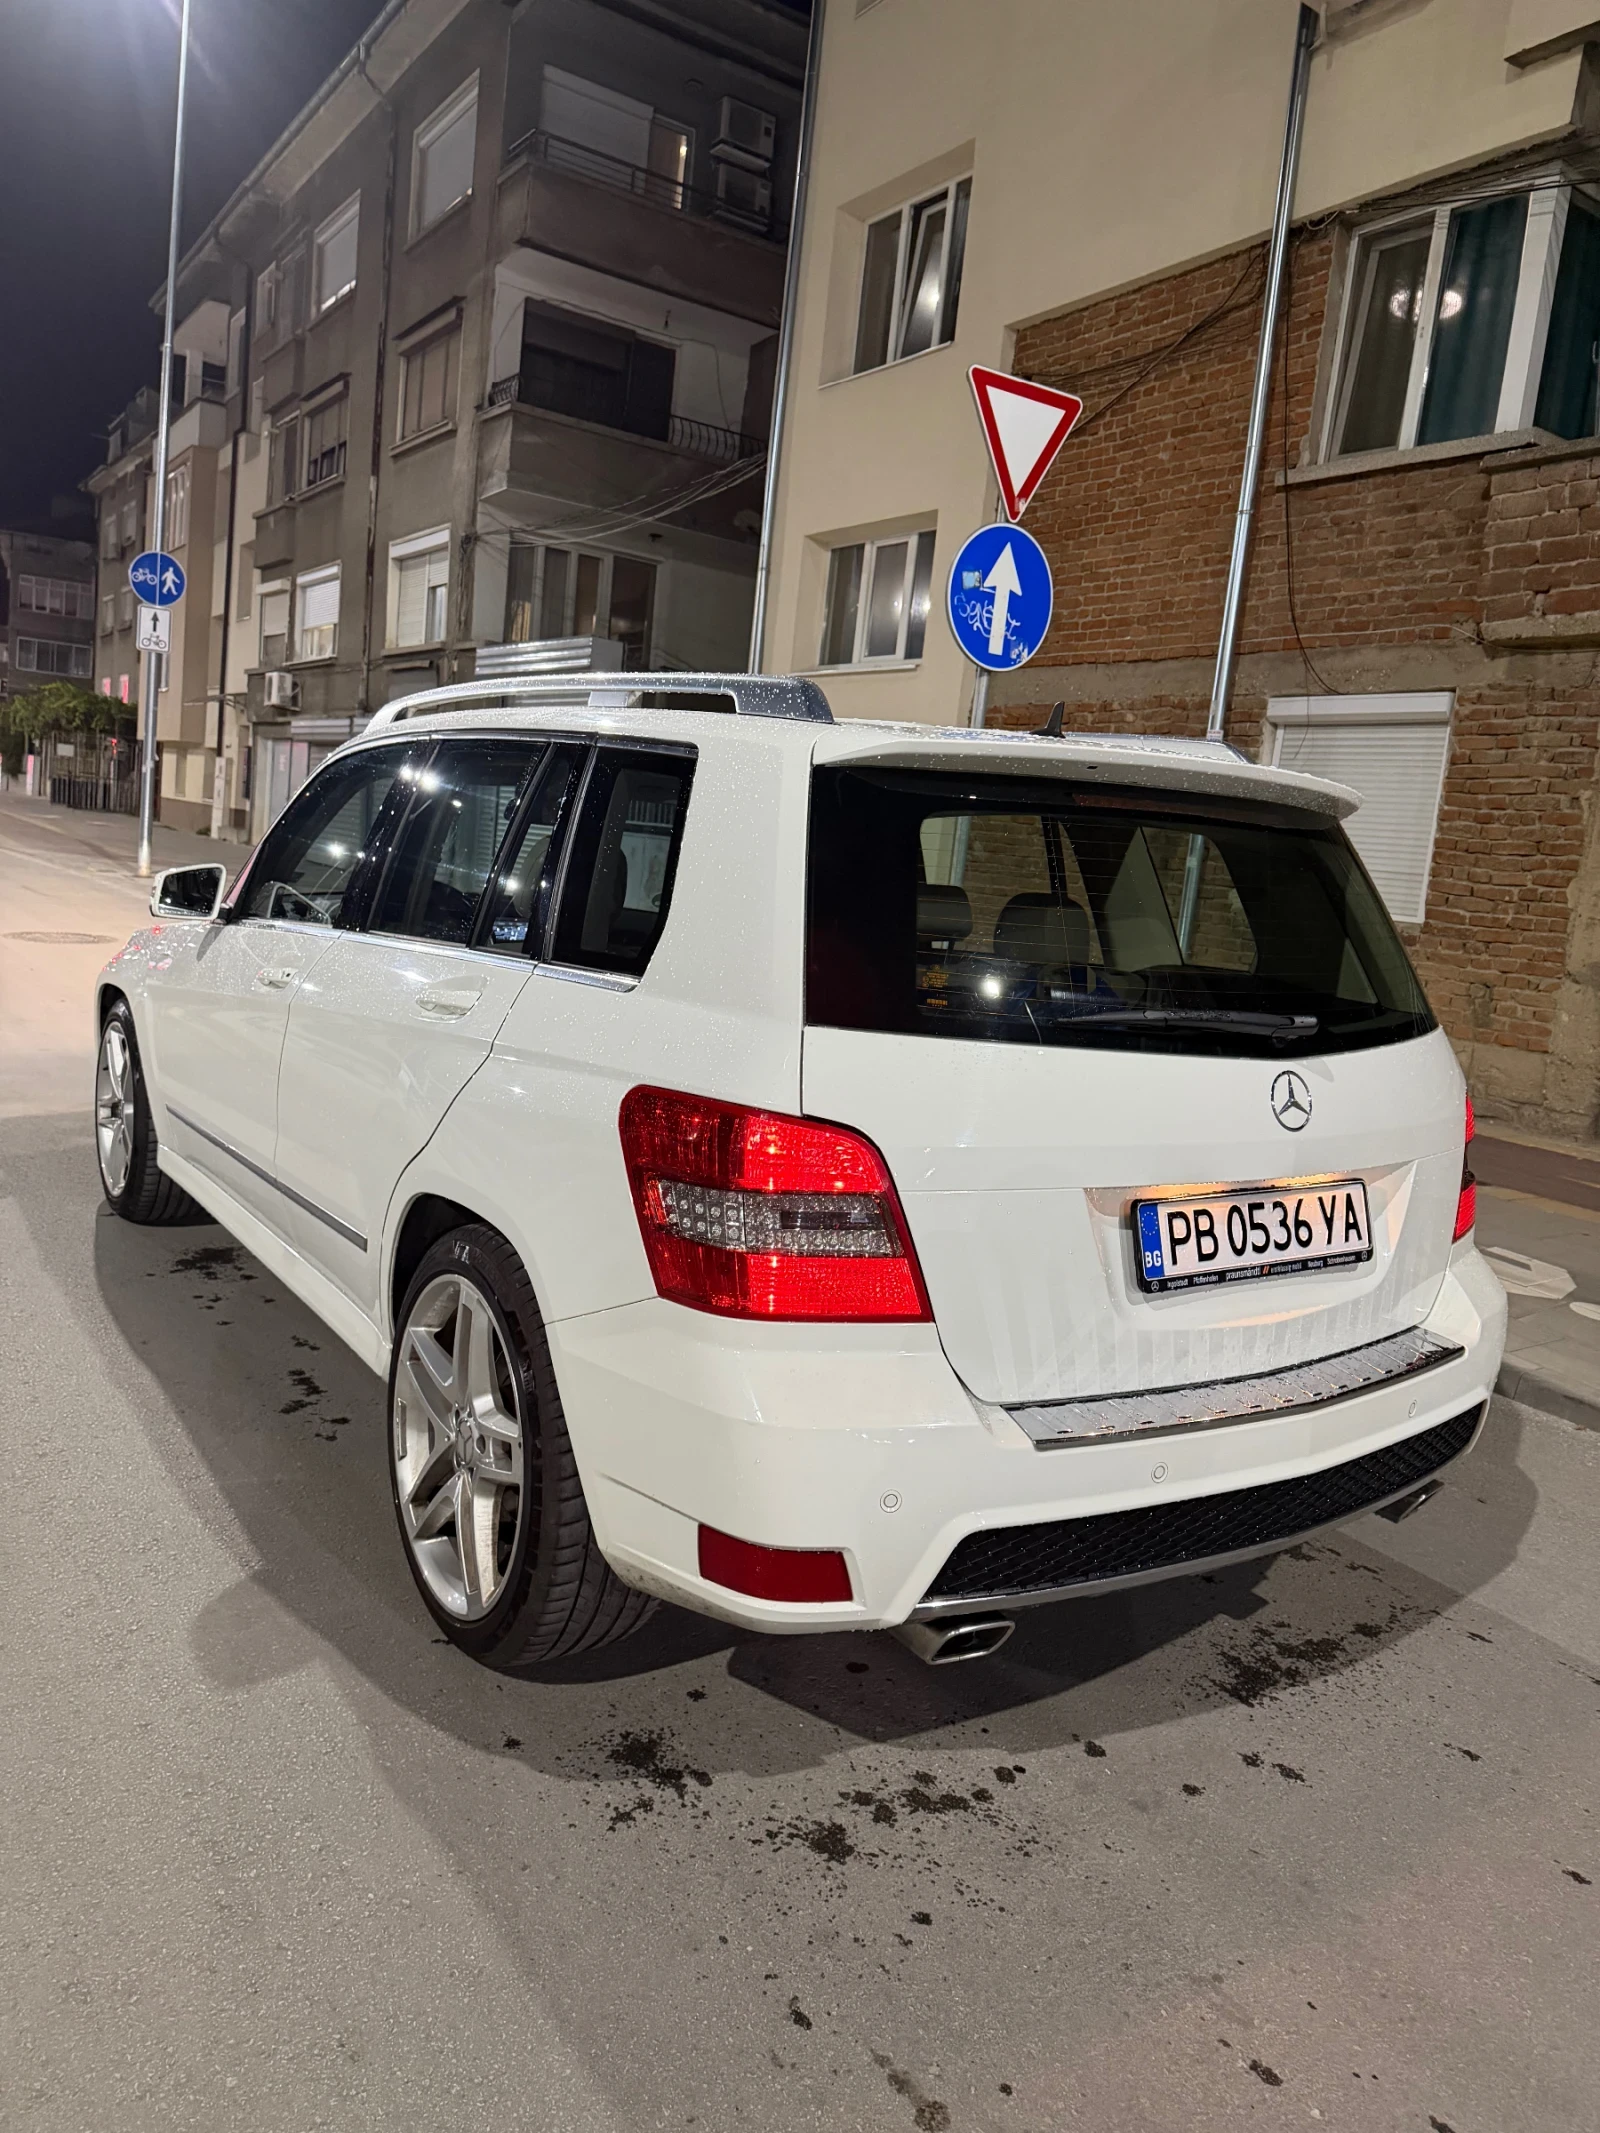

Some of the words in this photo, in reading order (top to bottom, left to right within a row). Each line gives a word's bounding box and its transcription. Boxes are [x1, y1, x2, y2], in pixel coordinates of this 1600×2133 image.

[1167, 1208, 1219, 1266] PB
[1227, 1198, 1313, 1257] 0536
[1317, 1192, 1363, 1245] YA
[1144, 1251, 1162, 1268] BG
